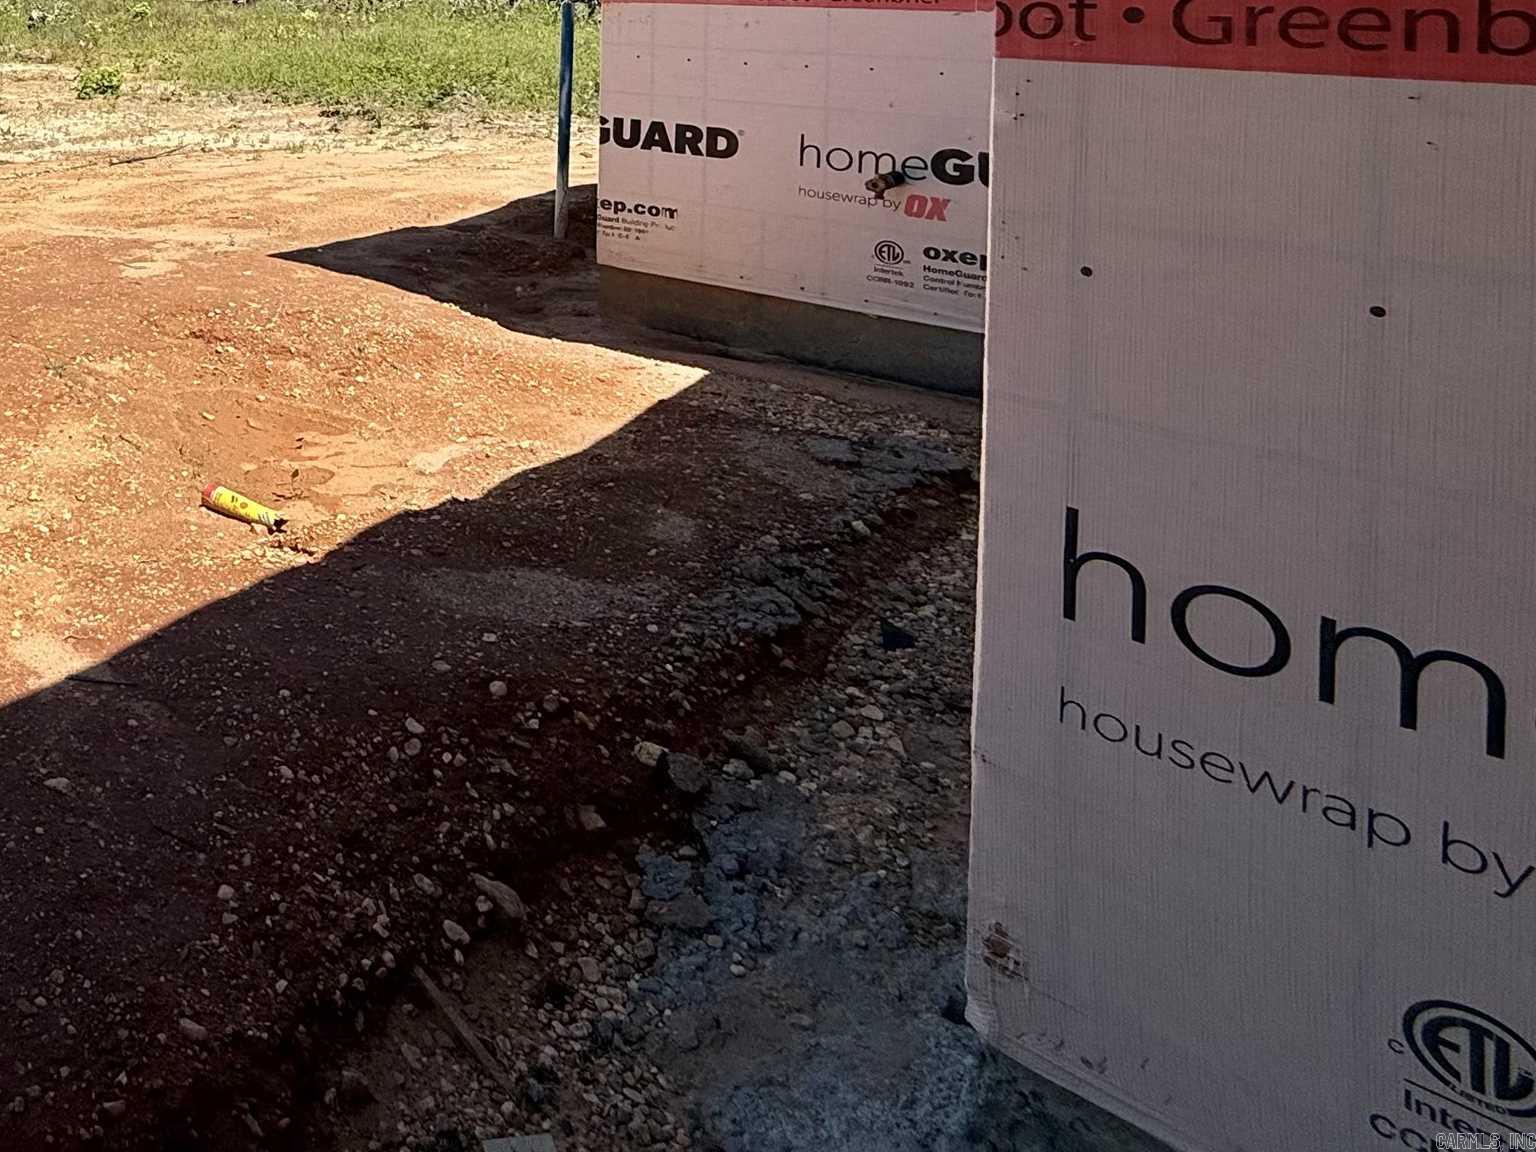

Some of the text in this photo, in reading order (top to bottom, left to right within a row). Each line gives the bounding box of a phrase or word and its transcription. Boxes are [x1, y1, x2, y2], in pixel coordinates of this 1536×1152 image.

[597, 199, 679, 220] ep.com
[798, 186, 952, 222] housewrap by OX
[1058, 685, 1536, 899] housewrap by
